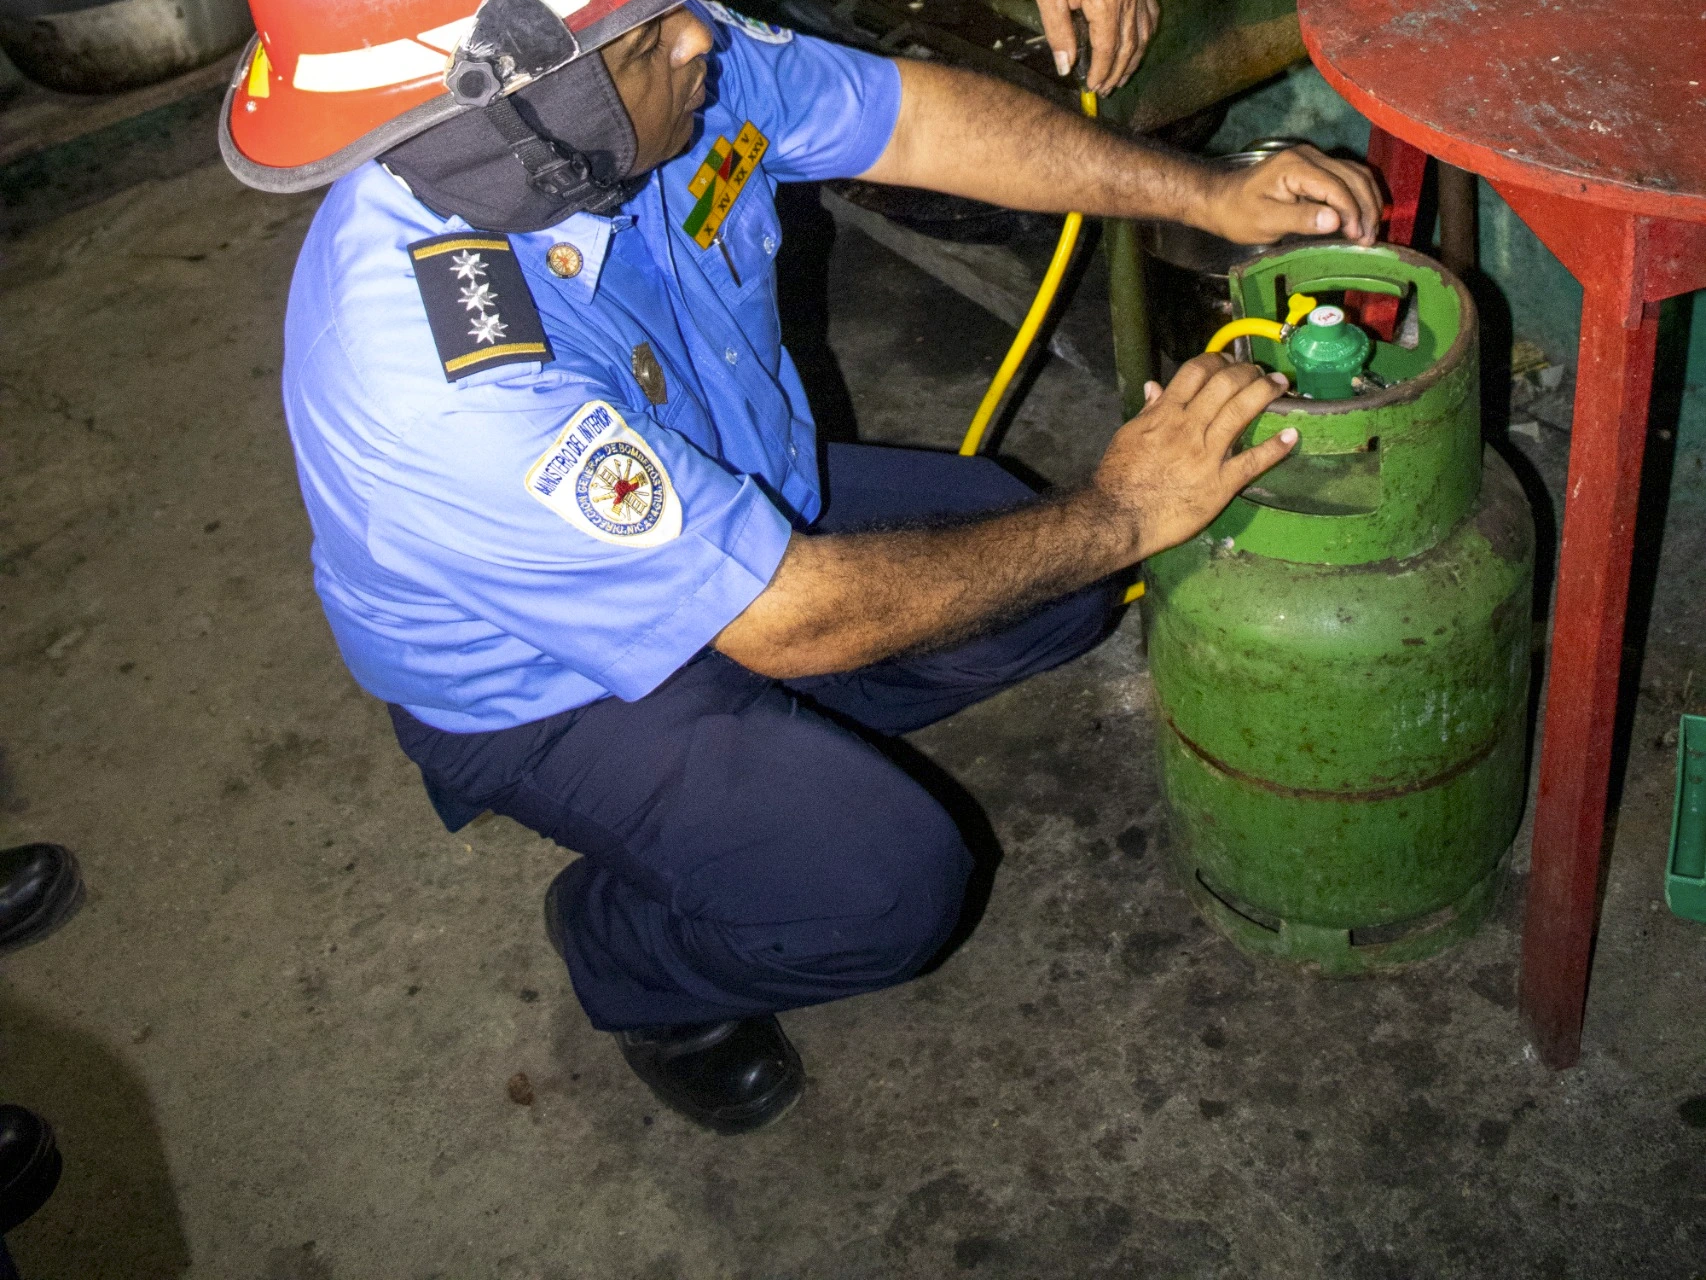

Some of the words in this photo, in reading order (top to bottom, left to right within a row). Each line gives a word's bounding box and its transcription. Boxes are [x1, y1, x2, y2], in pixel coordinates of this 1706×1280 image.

[741, 133, 750, 143] V
[748, 137, 765, 162] XXV
[734, 169, 748, 185] XX
[718, 193, 731, 212] XV
[703, 224, 714, 236] X
[577, 406, 614, 444] INTERIOR
[568, 434, 587, 457] DEL
[534, 446, 578, 497] MINISTERIO
[578, 454, 605, 492] GENERAL
[605, 445, 617, 455] DE
[619, 444, 661, 485] BOMBEROS
[627, 488, 662, 534] NICARAGUA
